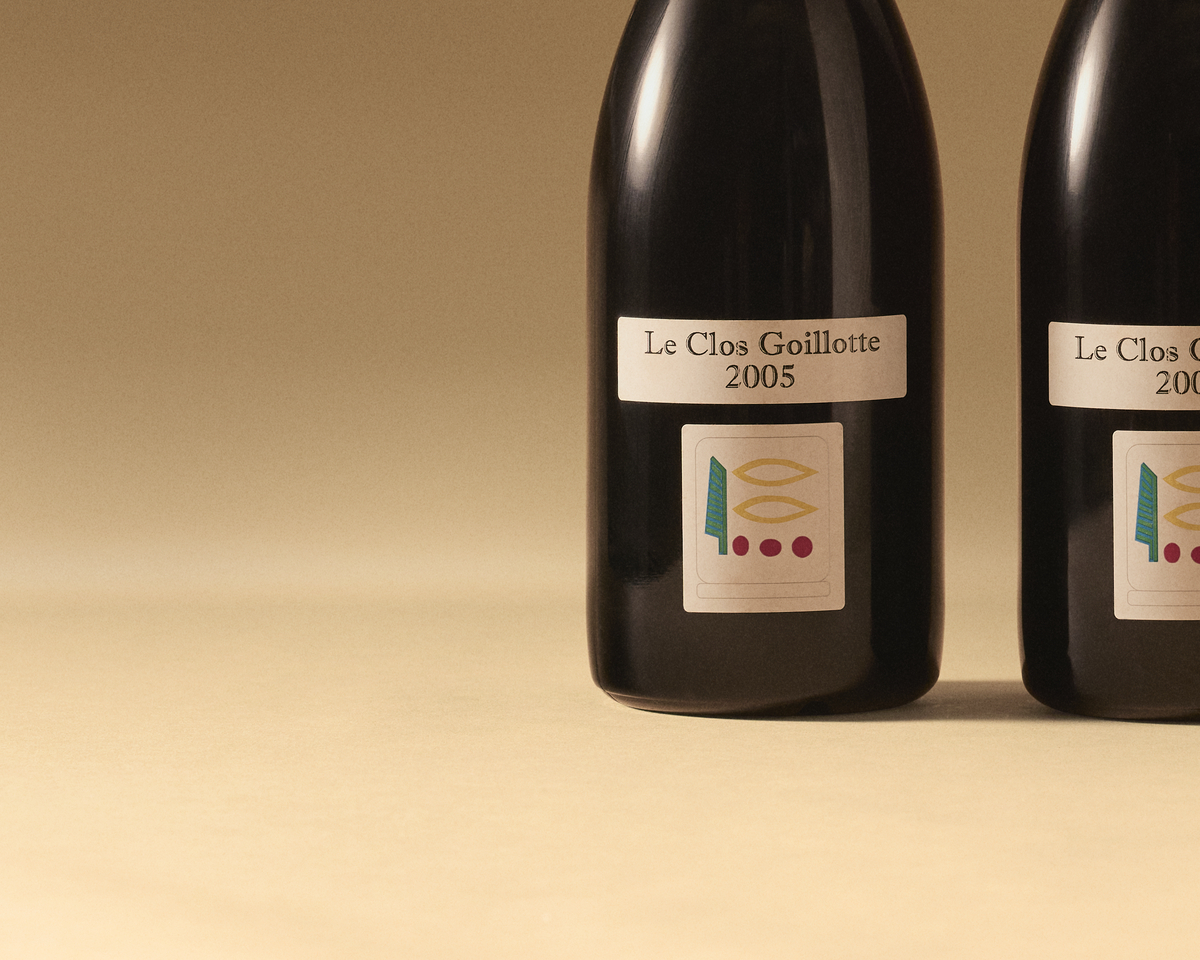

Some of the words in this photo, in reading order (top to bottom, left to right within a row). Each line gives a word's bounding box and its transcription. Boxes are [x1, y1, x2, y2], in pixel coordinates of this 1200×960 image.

[644, 330, 677, 355] Le
[685, 331, 748, 356] Clos
[758, 330, 881, 356] Goillotte
[1074, 336, 1107, 361] Le
[1115, 337, 1179, 362] Clos
[725, 364, 796, 389] 2005
